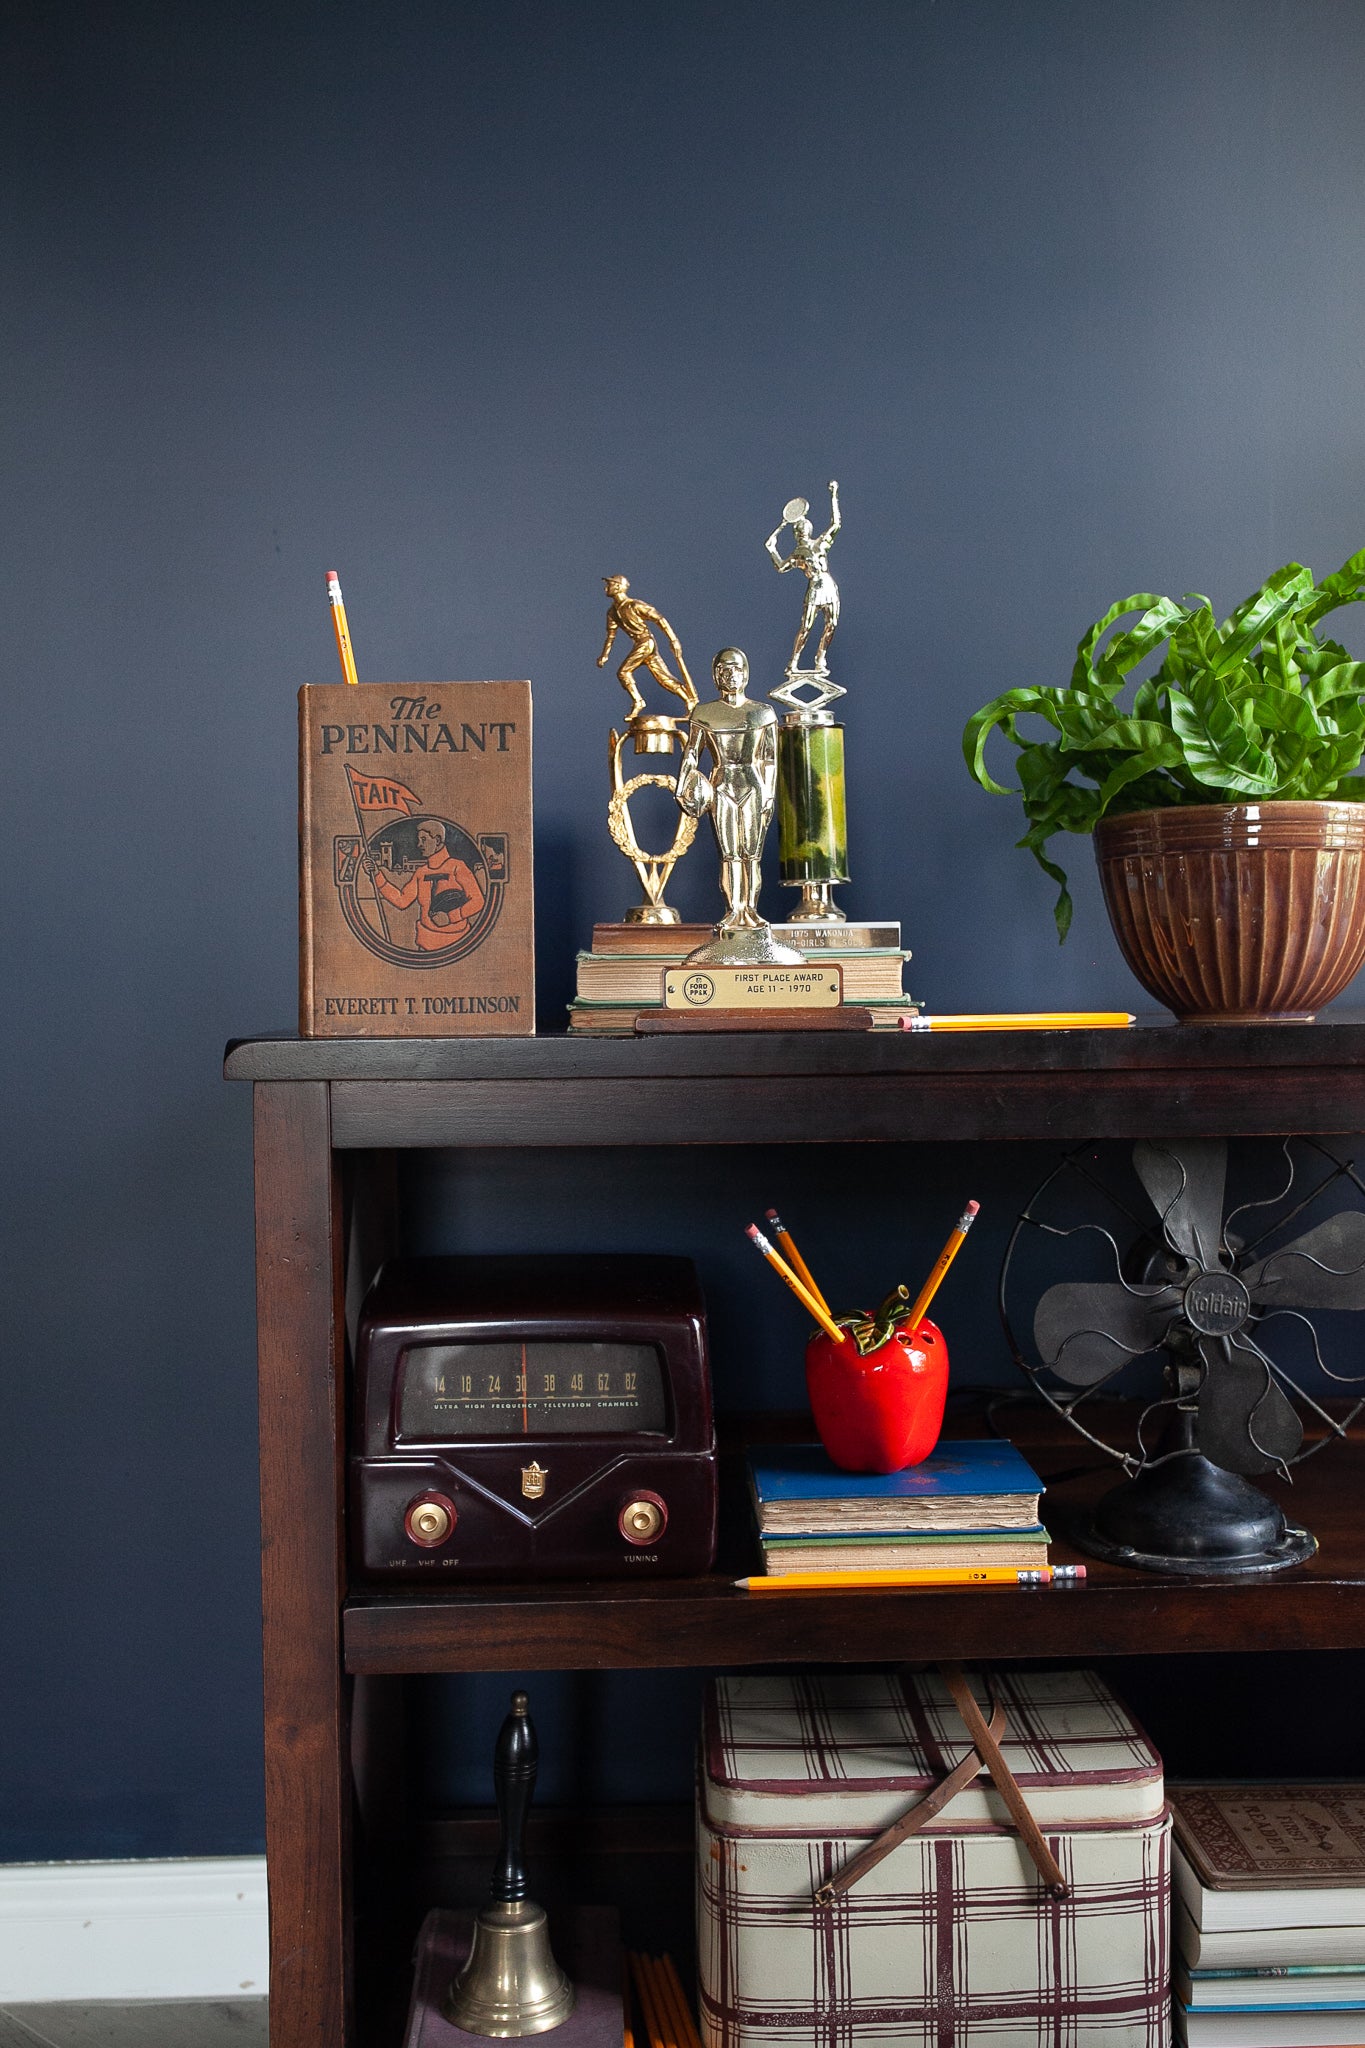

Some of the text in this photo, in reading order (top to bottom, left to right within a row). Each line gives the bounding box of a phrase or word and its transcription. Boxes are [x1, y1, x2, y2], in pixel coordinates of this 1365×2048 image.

[390, 696, 441, 720] The
[320, 722, 516, 754] PENNANT
[354, 780, 400, 805] TAIT
[791, 929, 854, 938] 1975 WAKONDA
[735, 973, 824, 982] FIRST PLACE AWARD
[747, 985, 765, 993] AGE
[325, 996, 520, 1016] EVERETT T. TOMLINSON
[1190, 1291, 1247, 1317] Koldair
[435, 1373, 637, 1393] 14 18 24 30 38 48 62 82
[1242, 1805, 1290, 1854] READER
[1276, 1815, 1309, 1842] FIRST
